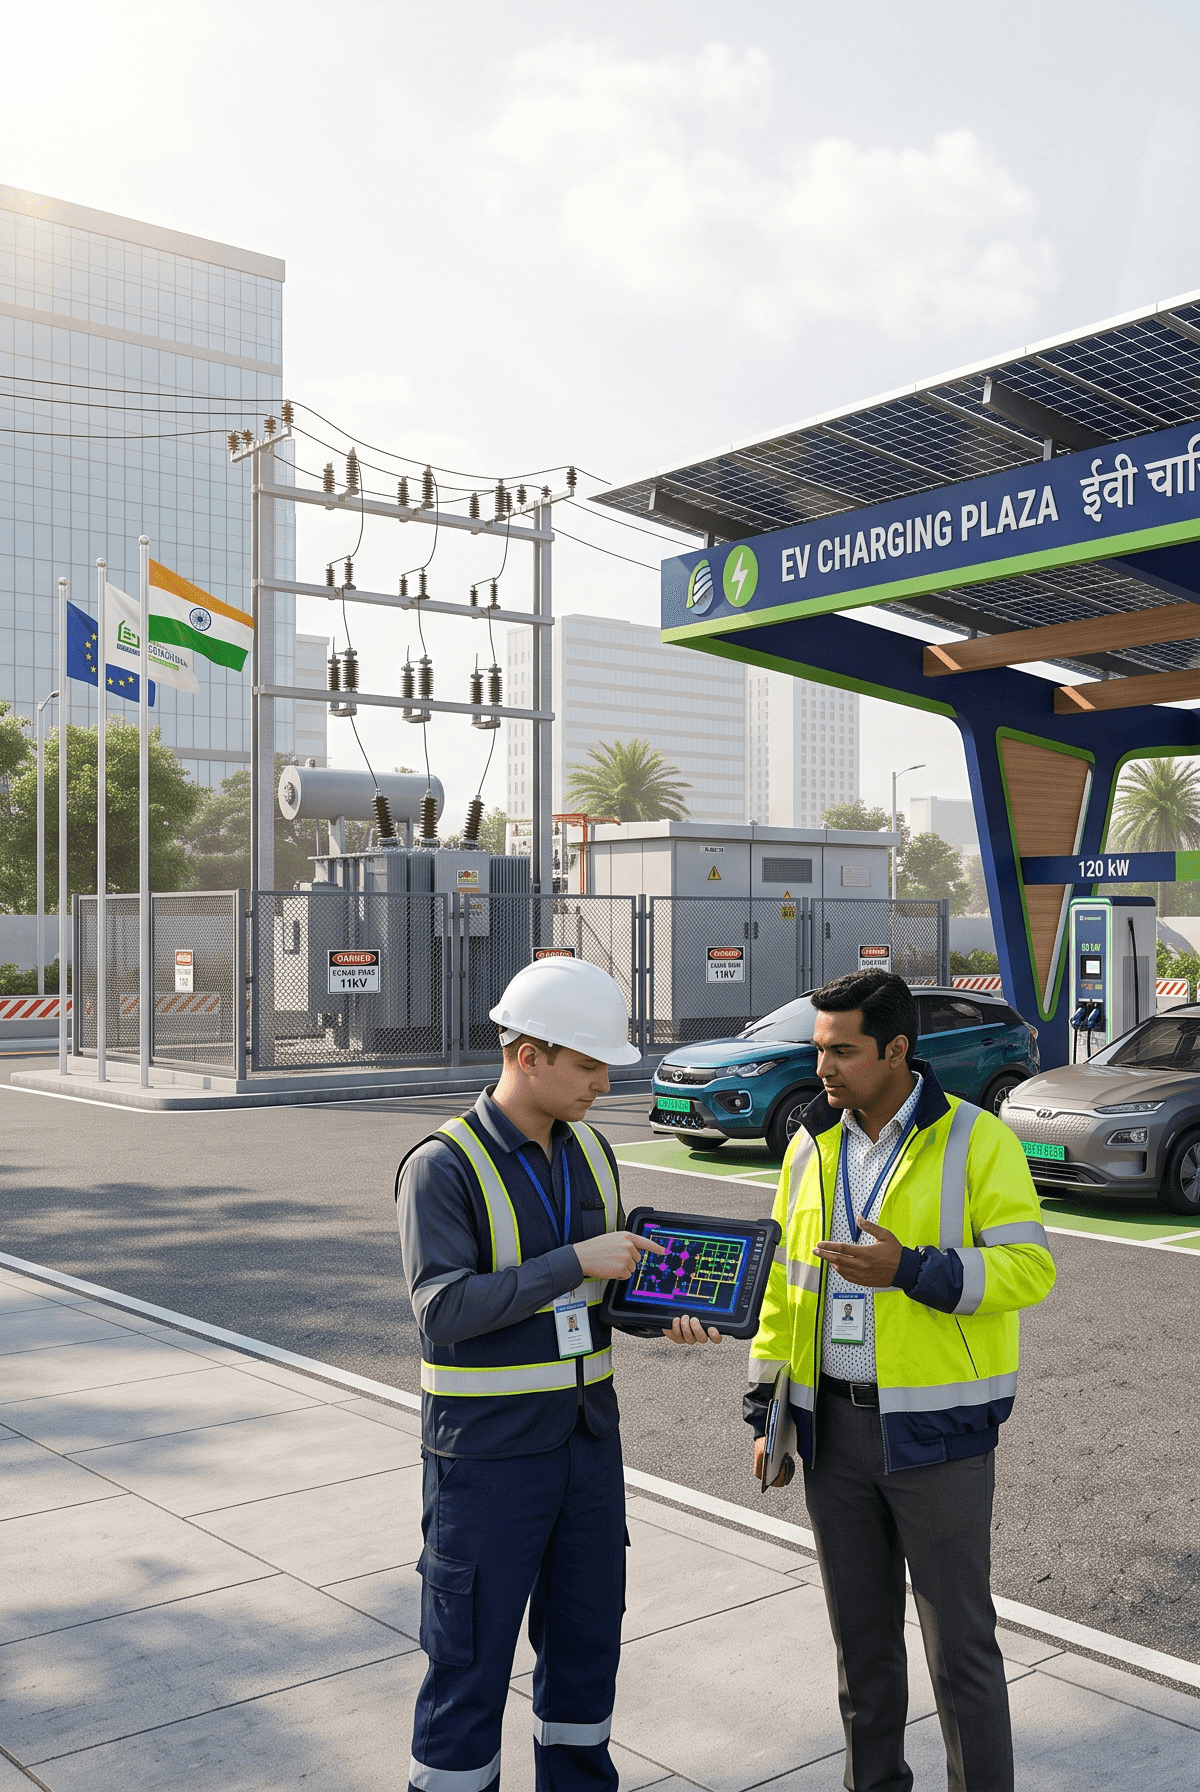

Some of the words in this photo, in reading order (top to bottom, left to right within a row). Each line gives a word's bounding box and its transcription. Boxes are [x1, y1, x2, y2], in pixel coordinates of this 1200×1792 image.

[1079, 453, 1139, 523] ईवी
[781, 544, 812, 583] EV
[817, 510, 953, 571] CHARGING
[961, 485, 1060, 542] PLAZA
[1078, 859, 1104, 878] 120
[1107, 858, 1130, 877] kW
[340, 978, 368, 988] 11kV
